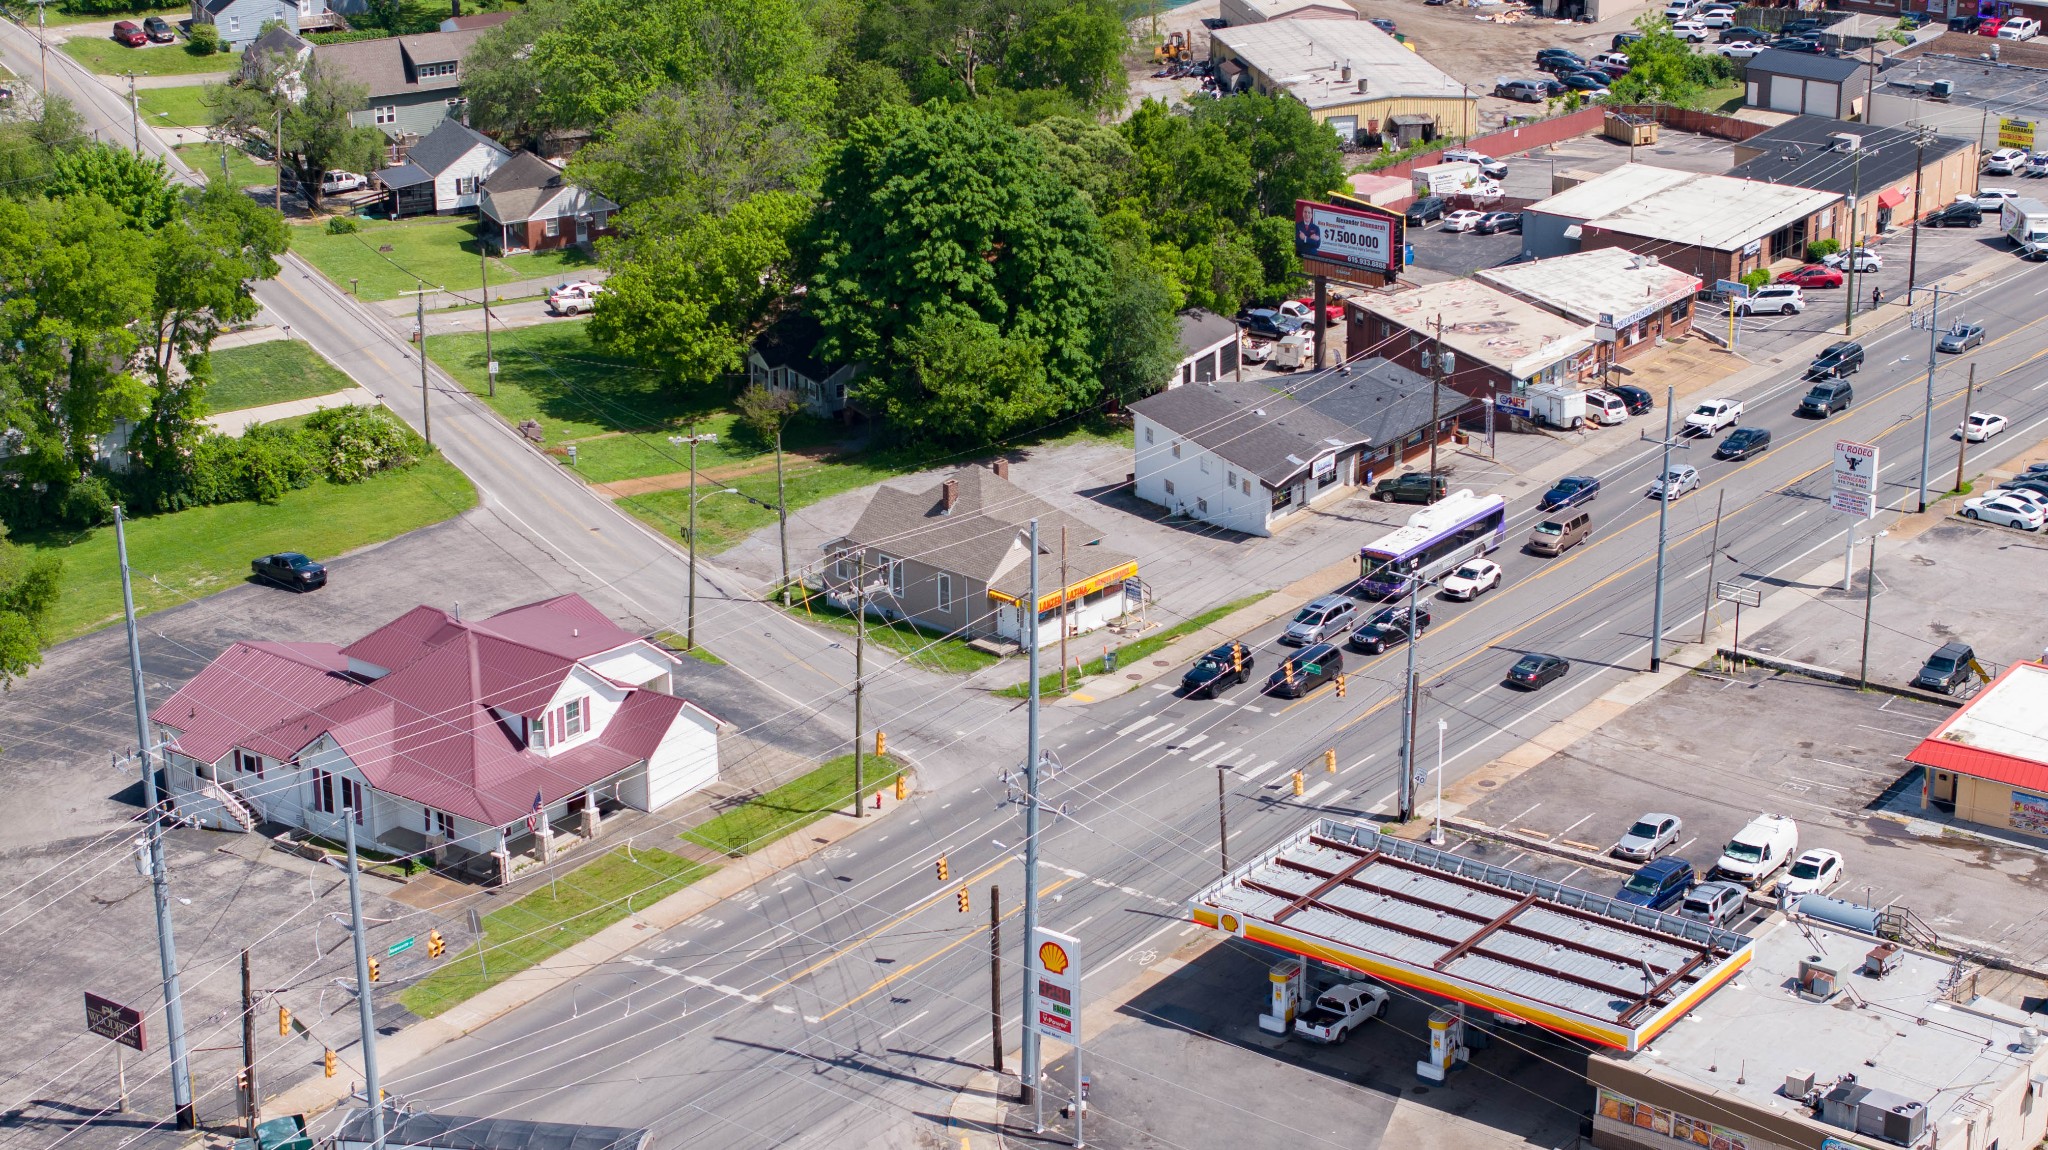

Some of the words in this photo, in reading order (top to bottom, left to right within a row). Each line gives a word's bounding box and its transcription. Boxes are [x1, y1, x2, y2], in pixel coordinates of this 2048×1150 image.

[1335, 216, 1359, 226] Alexander
[1324, 229, 1379, 249] $7,500,000
[1836, 443, 1844, 452] EL
[1847, 445, 1873, 458] RODEO
[1415, 776, 1425, 784] 40
[88, 1009, 138, 1038] WOODBINE
[1042, 1015, 1068, 1029] V-Power
[93, 1022, 115, 1038] Funeral
